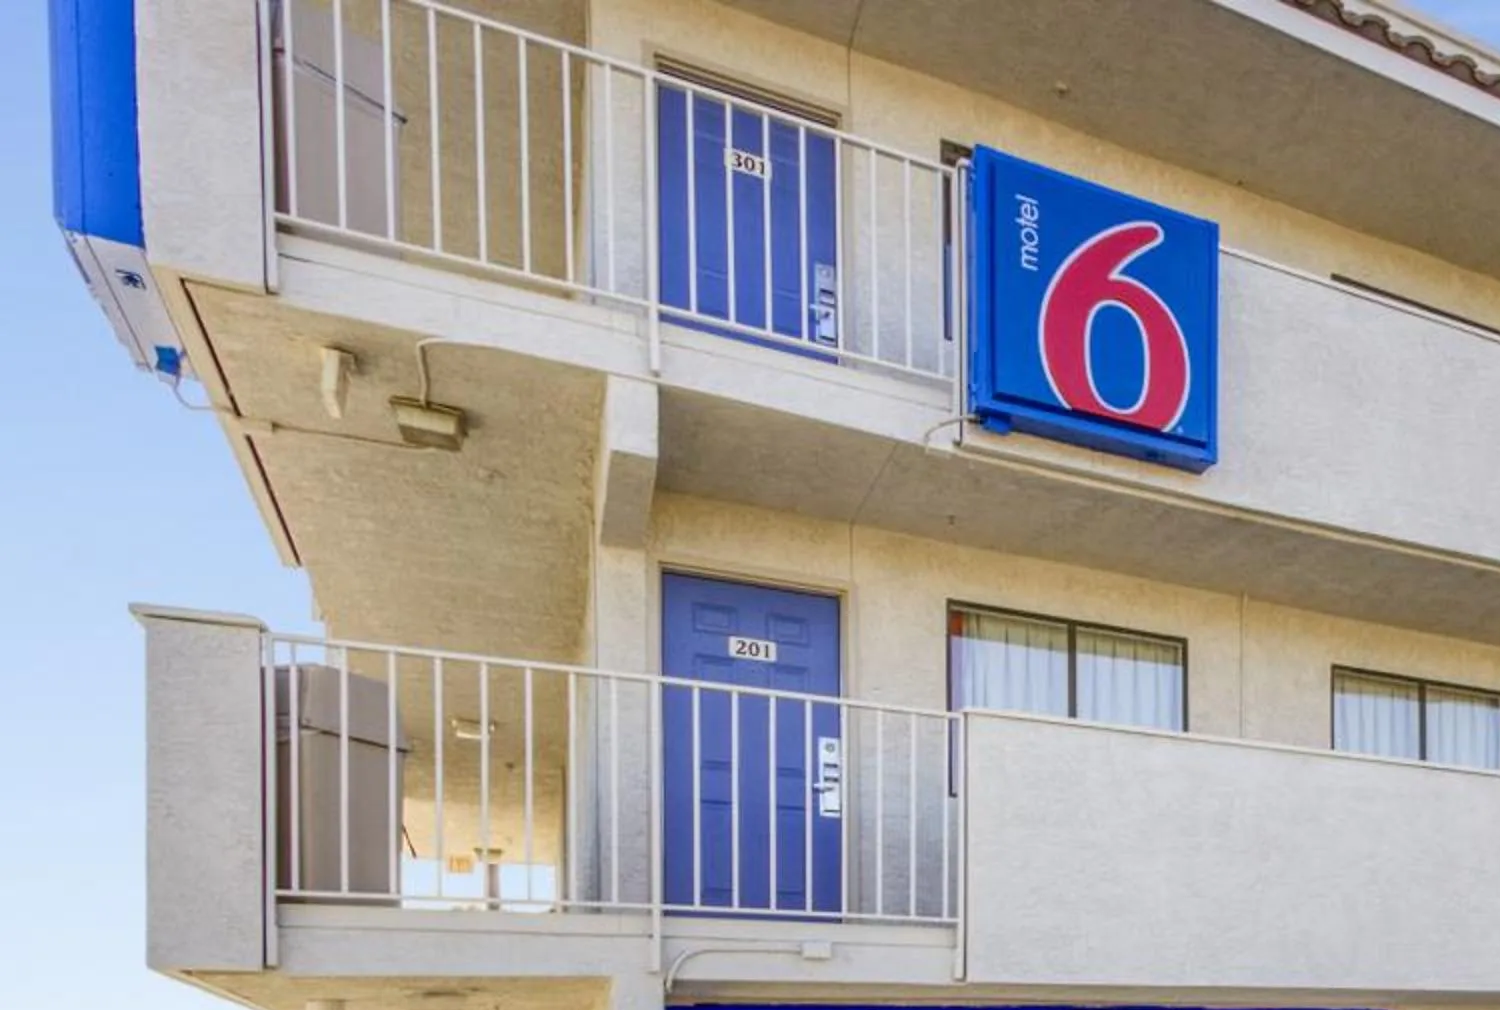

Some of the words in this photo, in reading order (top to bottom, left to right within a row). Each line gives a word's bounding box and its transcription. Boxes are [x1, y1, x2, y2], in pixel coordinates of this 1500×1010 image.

[730, 151, 766, 176] 301
[1015, 193, 1040, 271] motel
[1038, 220, 1191, 433] 6
[735, 639, 770, 658] 201
